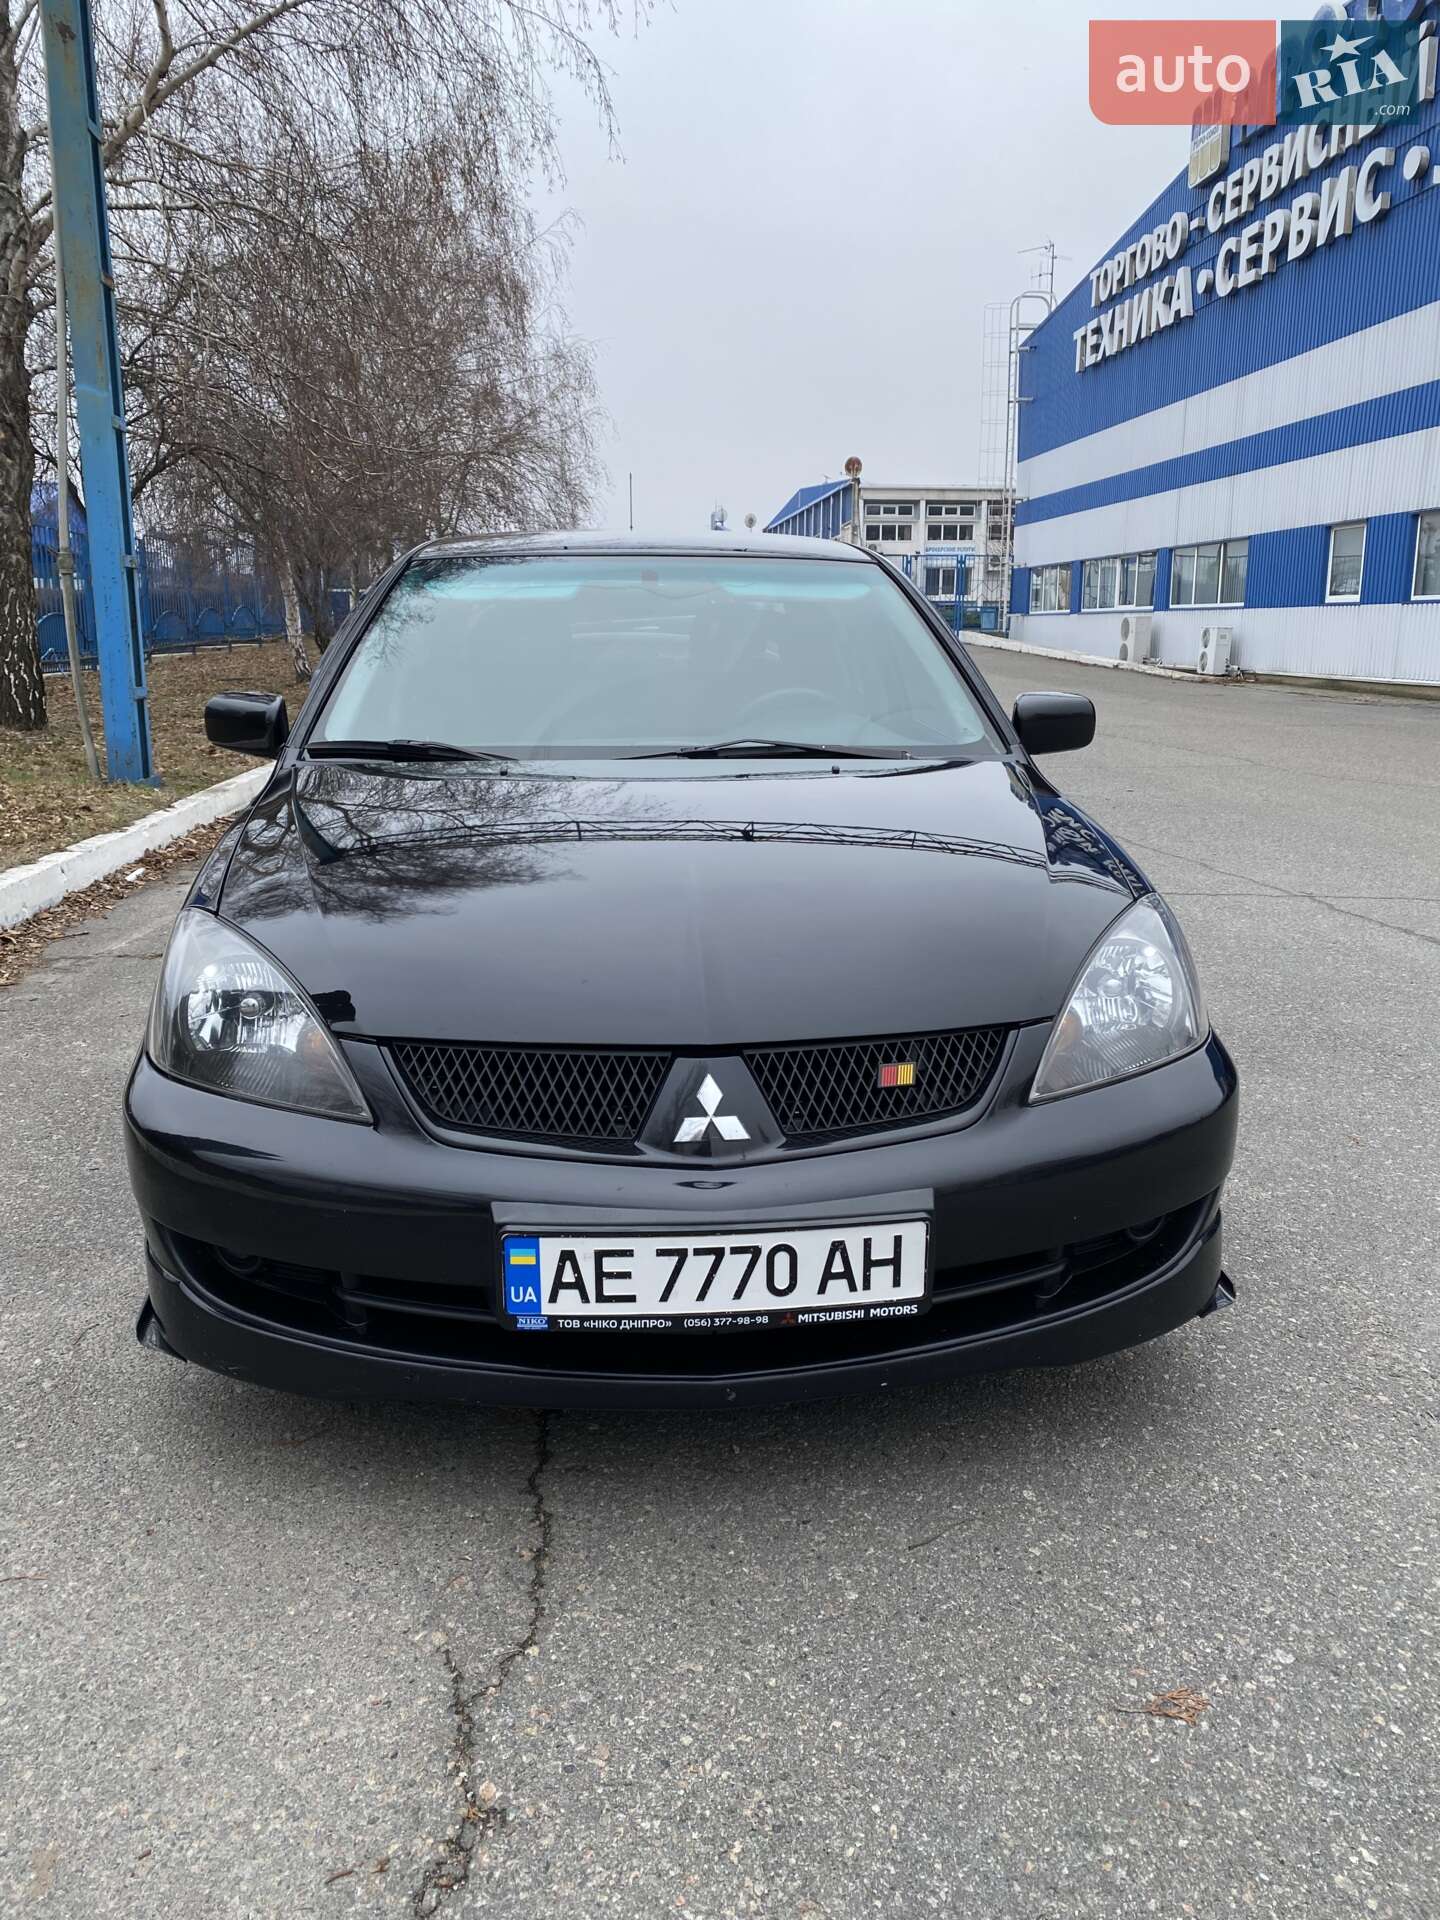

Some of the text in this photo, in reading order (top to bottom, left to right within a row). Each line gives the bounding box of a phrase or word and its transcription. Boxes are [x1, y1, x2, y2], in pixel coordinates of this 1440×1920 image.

[1072, 146, 1396, 374] ТЕХНИКА СЕРВИС
[547, 1234, 904, 1305] AE 7770 AH
[510, 1285, 538, 1304] UA
[557, 1316, 769, 1331] ТОВ «НІКО ДНІПРО» (056) 377-98-98
[798, 1304, 918, 1324] MITSUBISHI MOTORS
